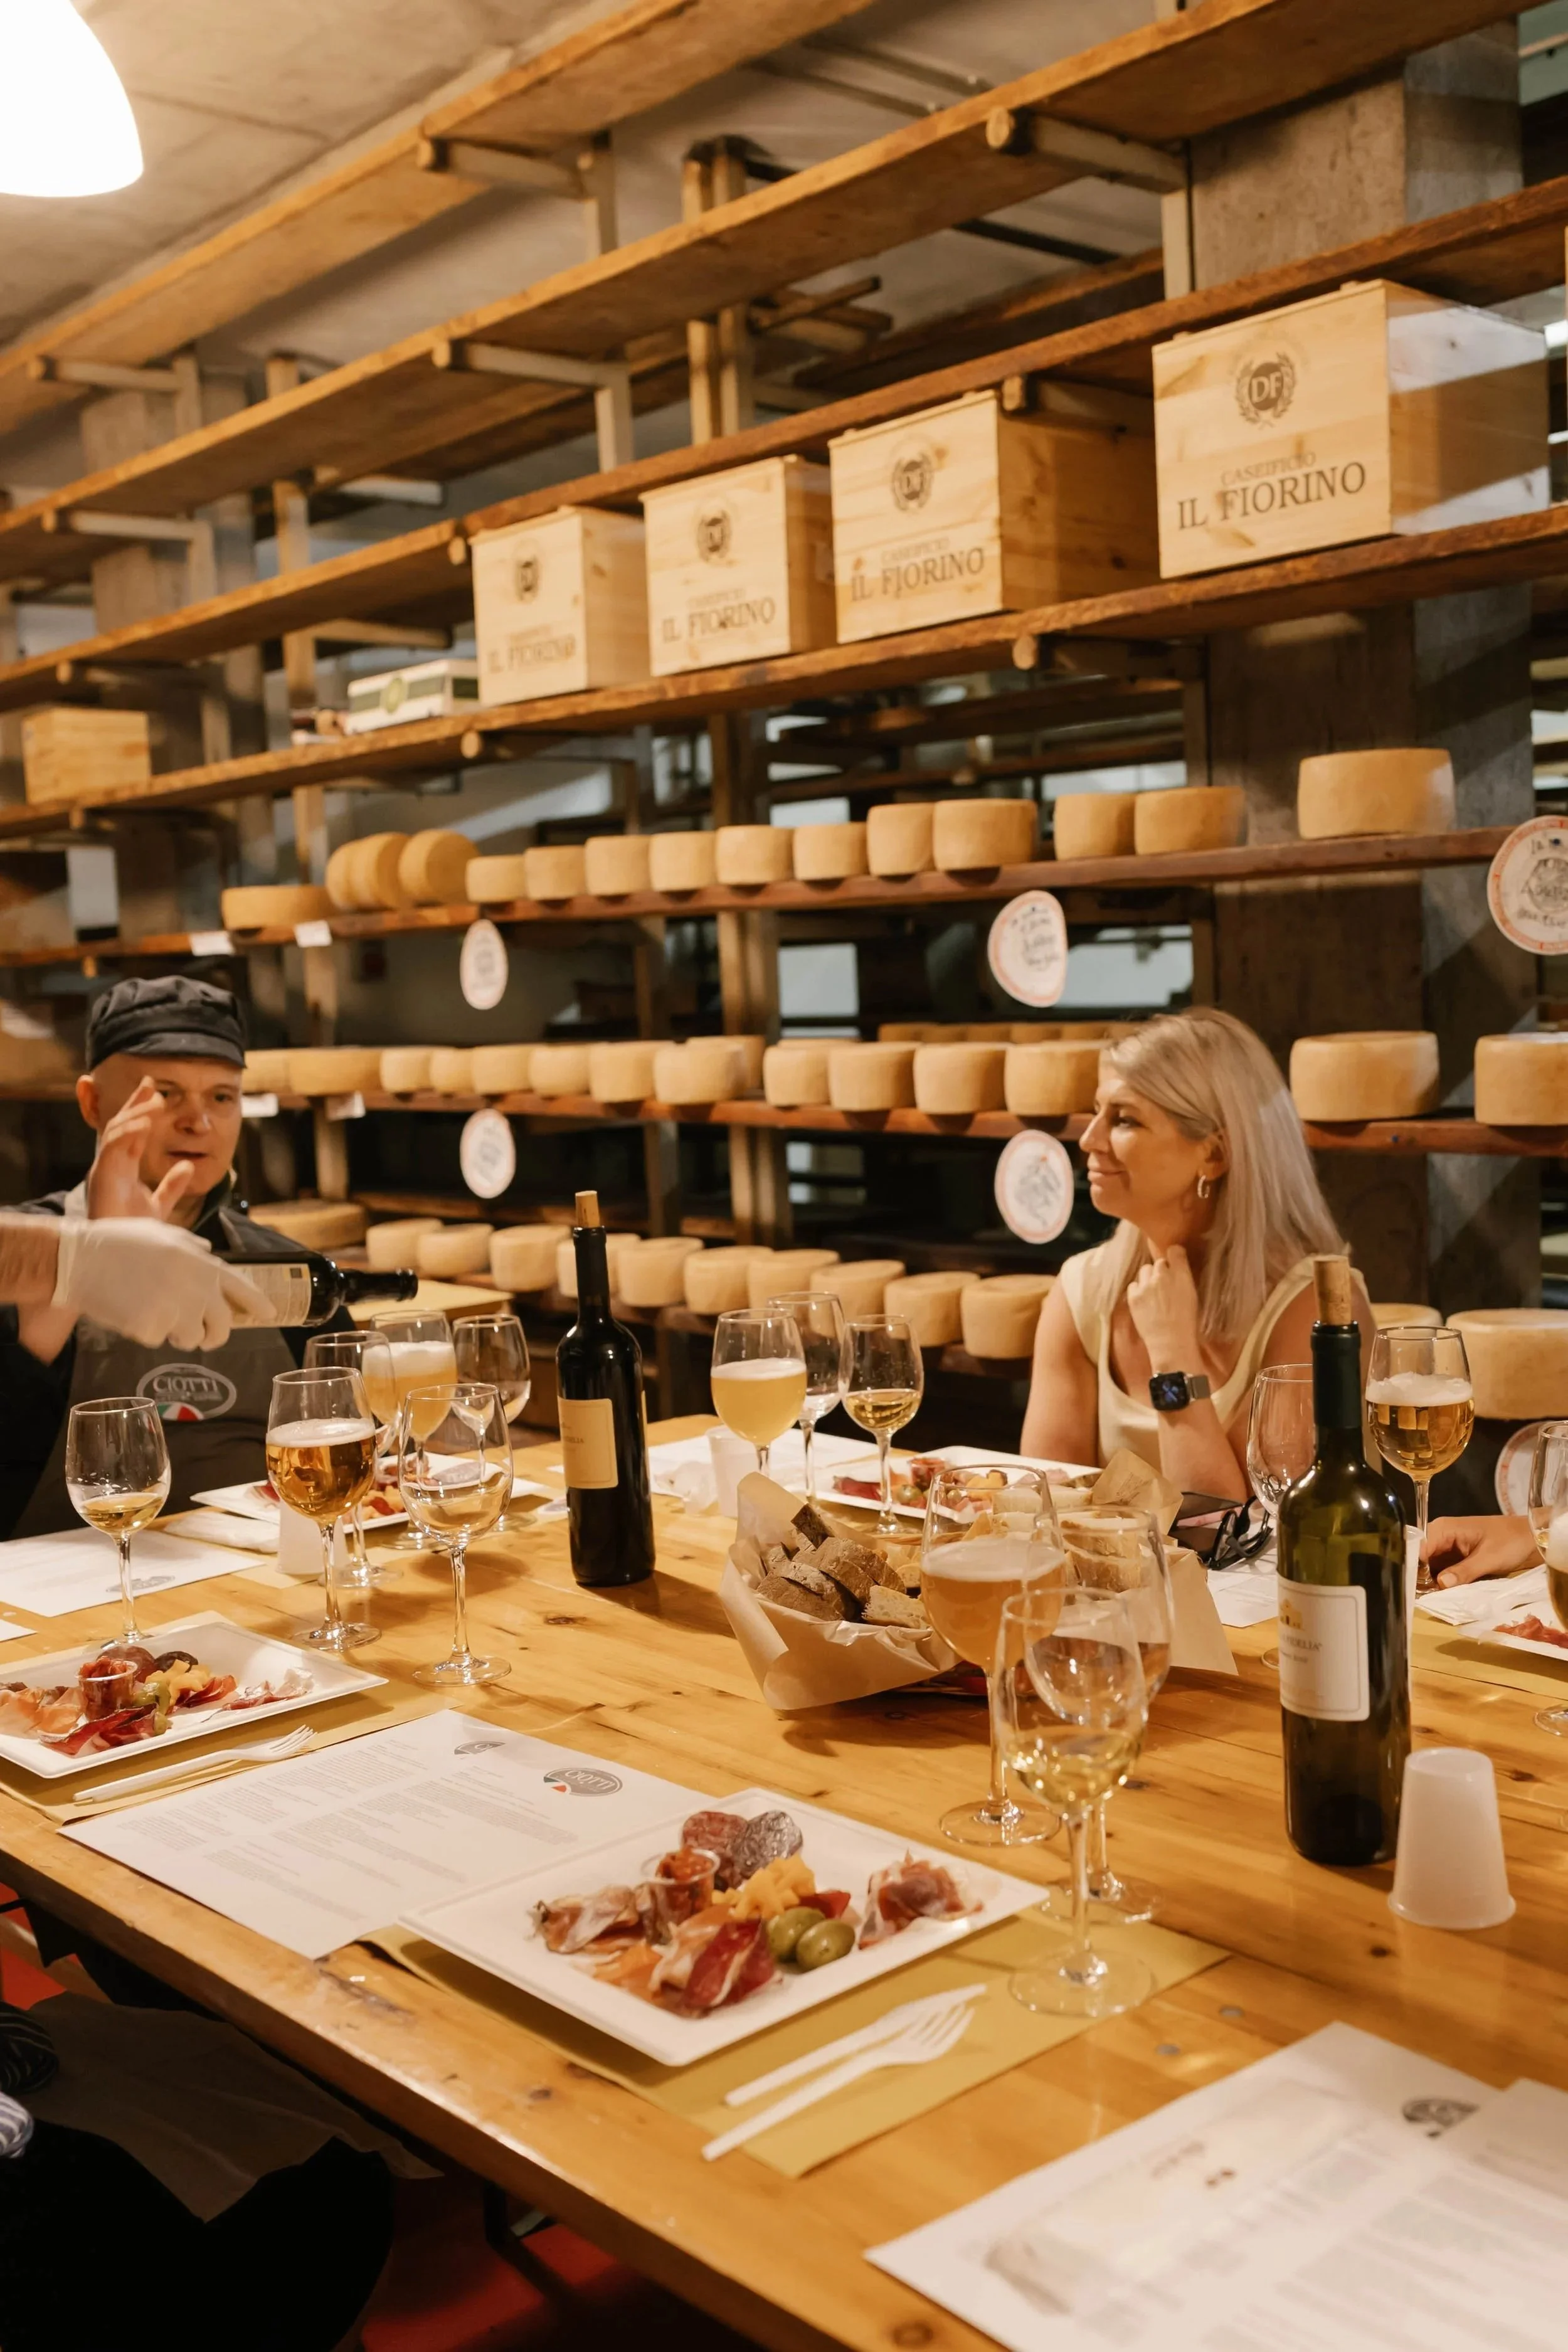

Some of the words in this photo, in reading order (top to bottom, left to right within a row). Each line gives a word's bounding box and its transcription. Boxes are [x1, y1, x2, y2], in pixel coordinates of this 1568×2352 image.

[1251, 371, 1282, 403] DF
[1221, 452, 1316, 486] CASEIFICIO
[1177, 497, 1208, 530] IL
[1219, 462, 1366, 522] FIORINO
[881, 547, 985, 598] FIORINO
[152, 1375, 219, 1394] CIOTTI
[564, 1770, 616, 1791] CIOTTI
